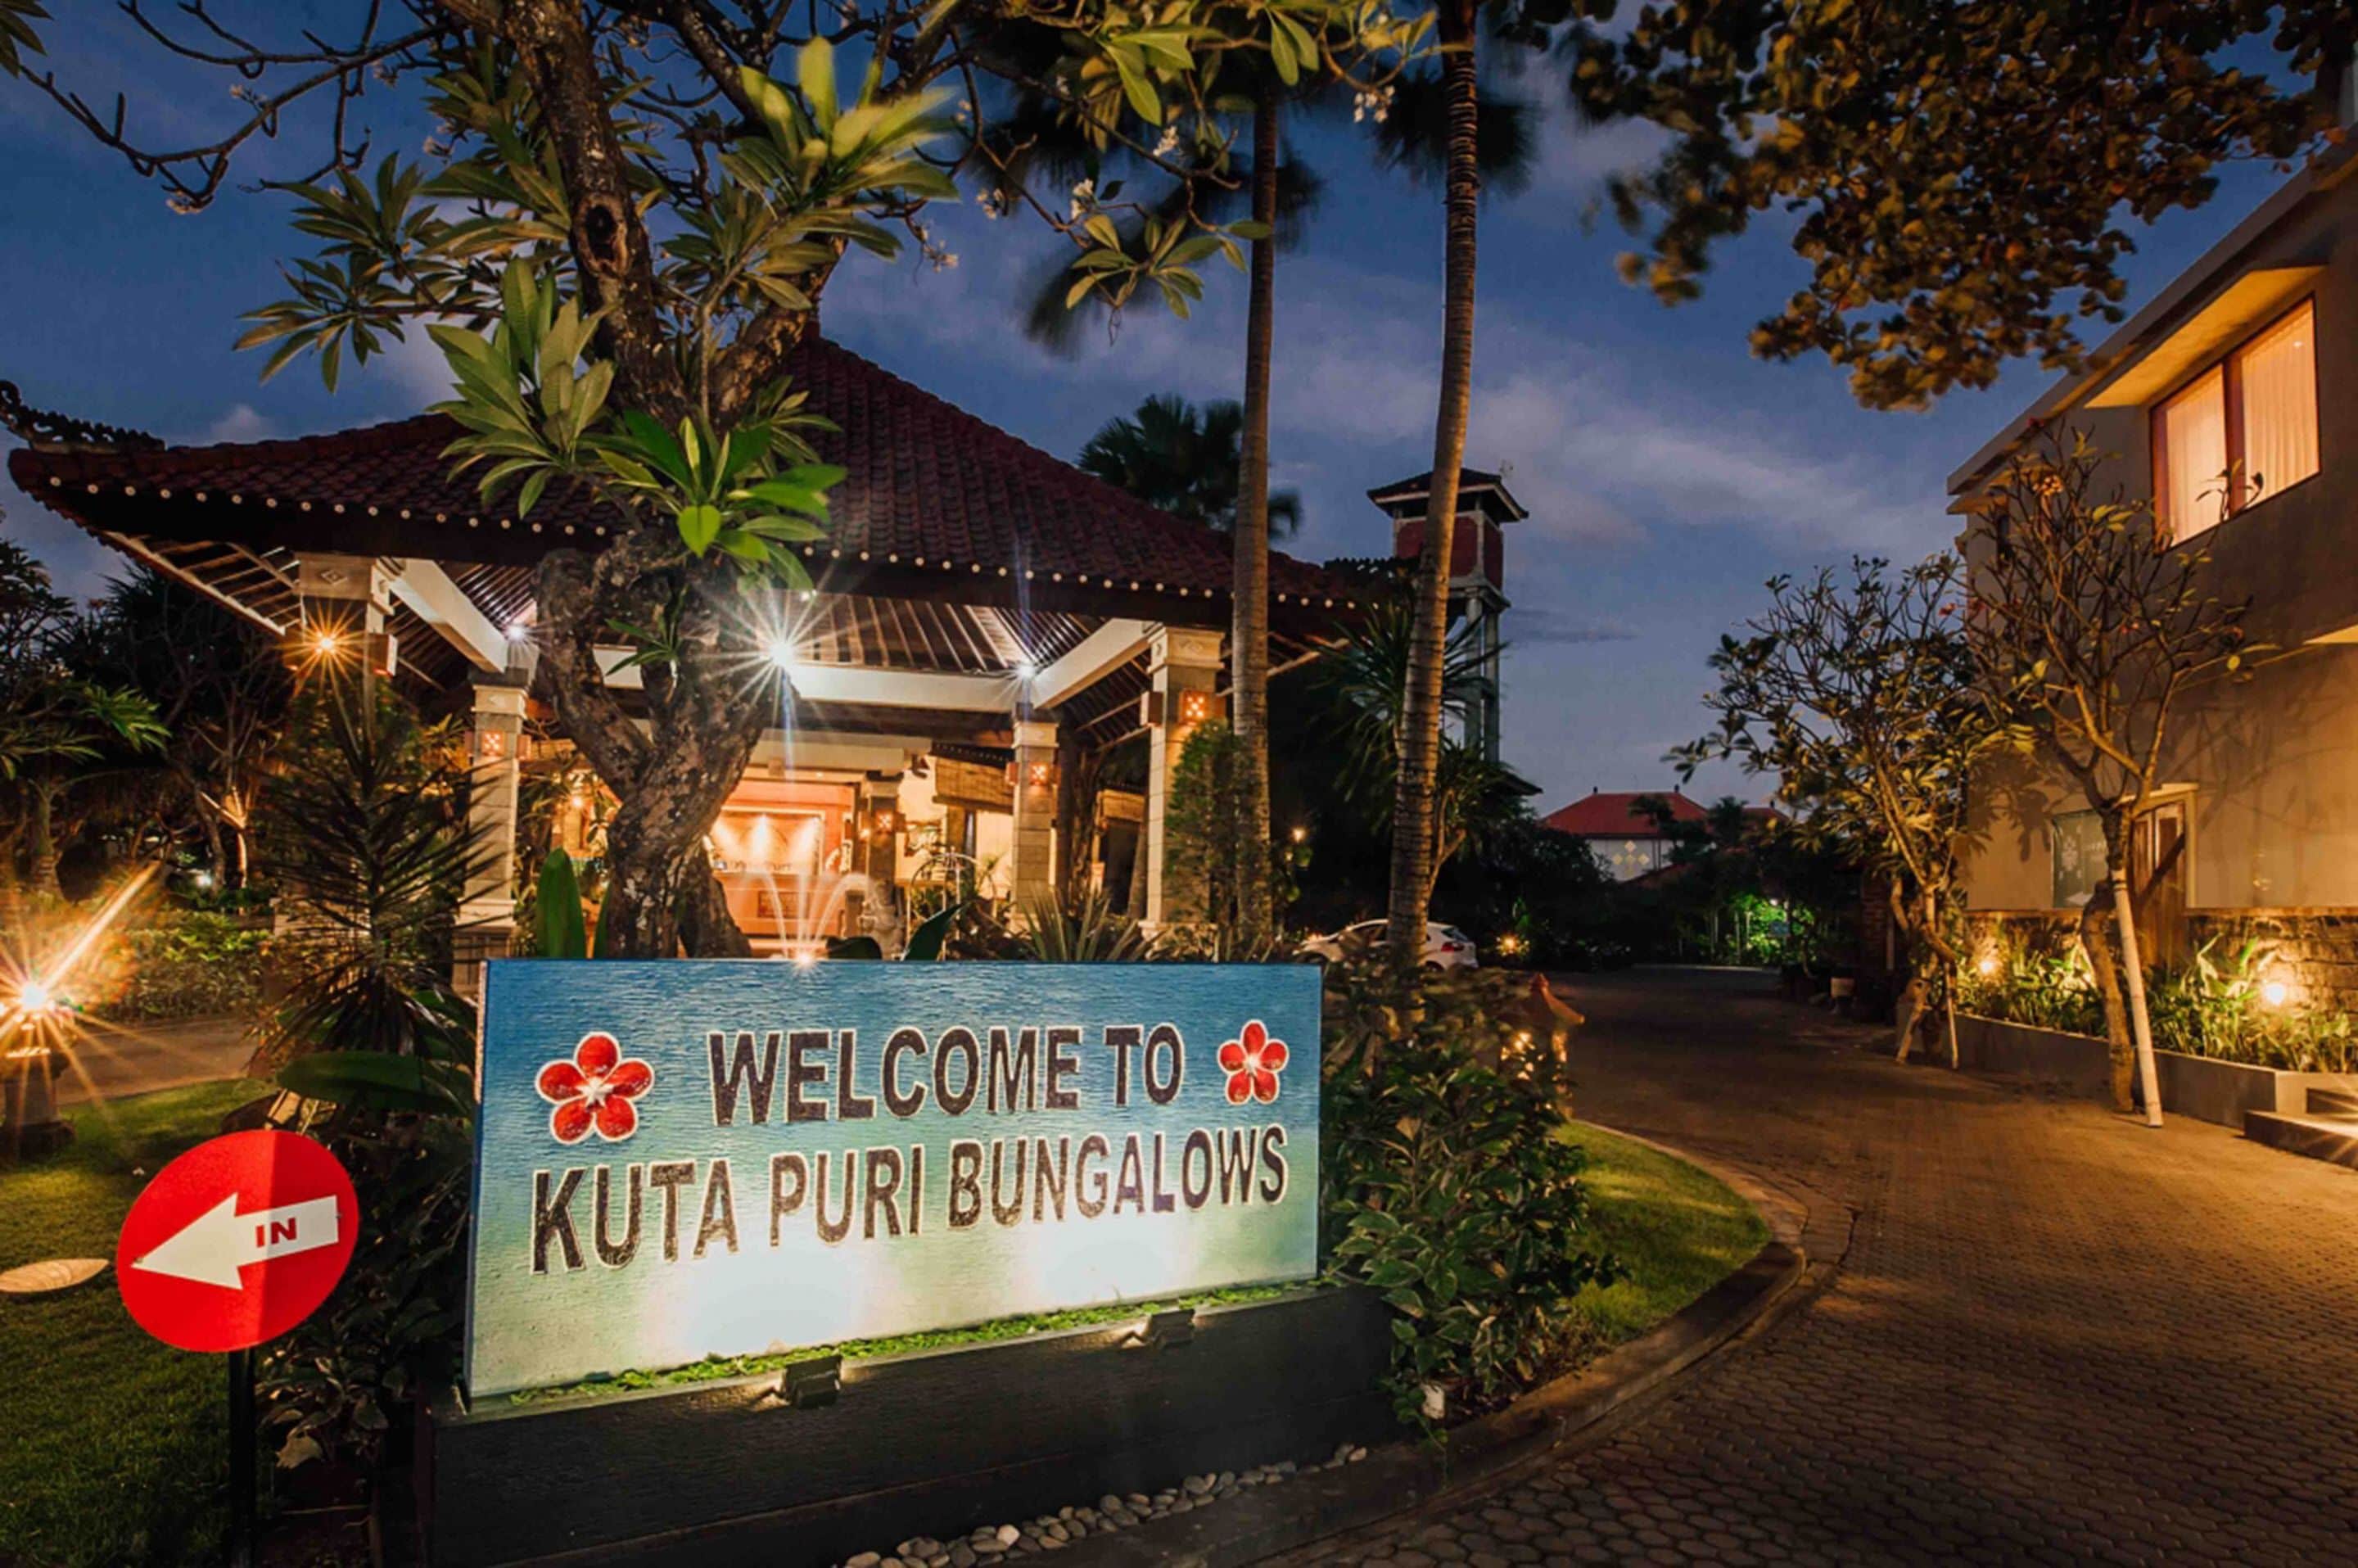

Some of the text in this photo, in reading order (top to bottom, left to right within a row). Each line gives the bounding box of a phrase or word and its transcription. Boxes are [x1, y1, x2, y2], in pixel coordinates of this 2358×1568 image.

[707, 1023, 1184, 1126] WELCOME TO
[255, 1217, 297, 1248] IN
[530, 1123, 1289, 1275] KUTA PURI BUNGALOWS
